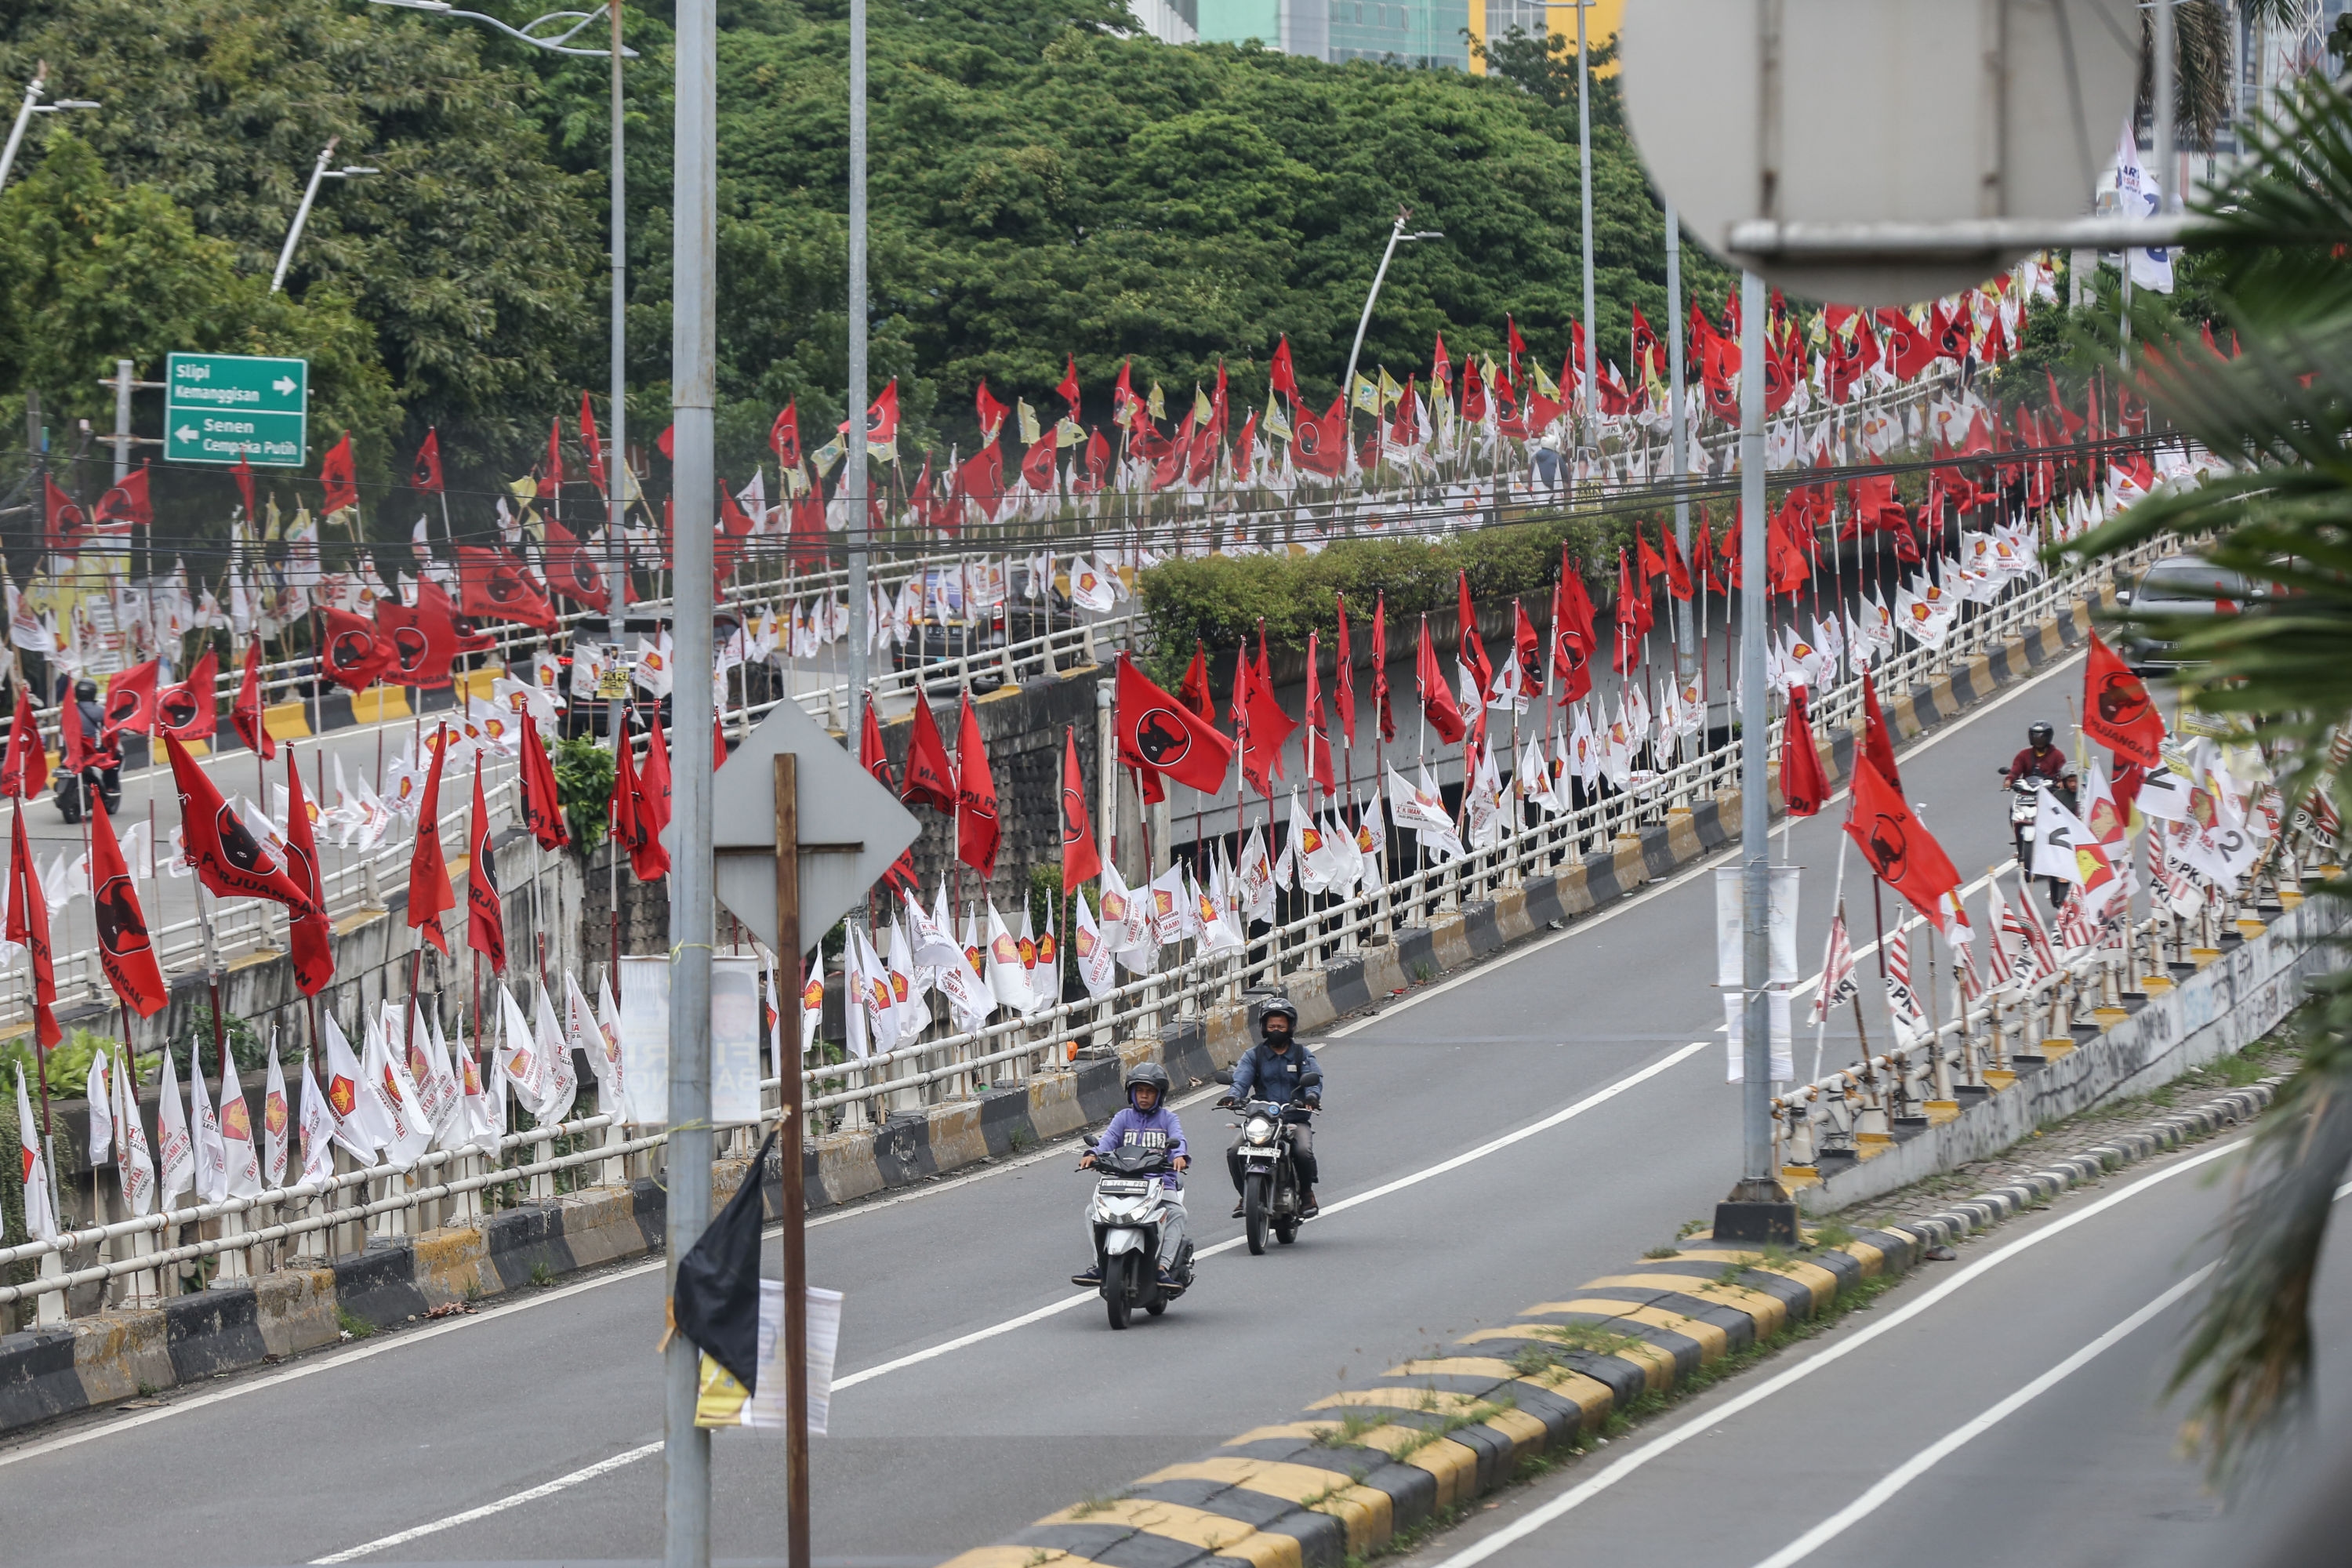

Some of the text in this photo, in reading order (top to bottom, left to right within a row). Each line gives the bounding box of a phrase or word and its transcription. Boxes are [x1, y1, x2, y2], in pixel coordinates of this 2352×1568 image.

[176, 364, 211, 382] Slipi
[175, 385, 260, 404] Kemanggisan
[204, 419, 254, 433] Senen
[203, 438, 297, 456] Cempaka Putih
[2219, 830, 2244, 862] 2
